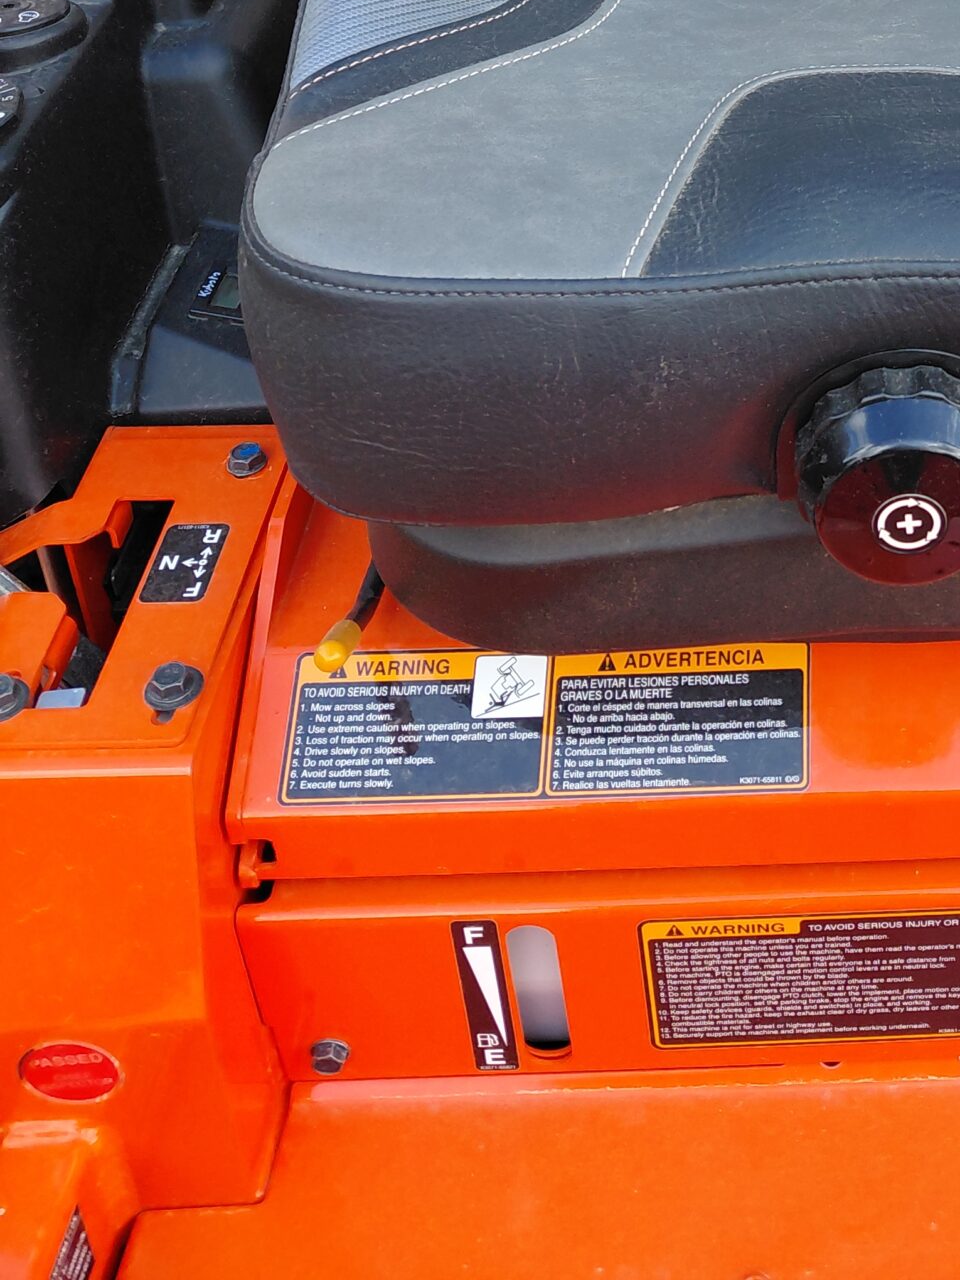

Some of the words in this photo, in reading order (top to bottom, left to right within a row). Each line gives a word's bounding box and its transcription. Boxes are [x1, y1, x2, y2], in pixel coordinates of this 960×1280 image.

[203, 529, 222, 543] R
[159, 555, 180, 570] N
[183, 582, 202, 597] F
[624, 649, 765, 669] ADVERTENCIA
[356, 659, 449, 677] WARNING
[561, 679, 588, 690] PARA
[590, 678, 626, 689] EVITAR
[628, 676, 679, 687] LESIONES
[681, 674, 750, 686] PERSONALES
[304, 688, 316, 698] TO
[318, 687, 345, 698] AVOID
[347, 686, 388, 697] SERIOUS
[390, 685, 423, 696] INJURY
[424, 685, 438, 695] OR
[440, 684, 471, 694] DEATH
[561, 691, 602, 701] GRAVES
[604, 690, 613, 700] O
[615, 690, 629, 699] LA
[630, 688, 673, 699] MUERTE
[301, 704, 308, 712] 1.
[311, 703, 332, 712] Mow
[334, 703, 364, 712] across
[366, 702, 395, 711] slopes
[568, 703, 591, 712] Corte
[593, 703, 601, 711] el
[602, 702, 633, 712] césped
[634, 702, 645, 711] de
[647, 702, 678, 710] manera
[681, 699, 725, 709] transversal
[740, 698, 752, 706] las
[754, 697, 783, 706] colinas
[315, 714, 331, 723] Not
[333, 715, 344, 723] up
[347, 713, 364, 722] and
[365, 713, 392, 721] down.
[572, 714, 585, 723] No
[587, 714, 598, 722] de
[626, 713, 648, 721] hacia
[650, 712, 675, 722] abajo.
[296, 726, 304, 735] 2.
[308, 725, 325, 734] Use
[328, 725, 364, 733] extreme
[366, 724, 399, 732] caution
[401, 722, 426, 732] when
[428, 721, 469, 733] operating
[486, 721, 517, 730] slopes.
[295, 737, 303, 745] 3.
[306, 736, 327, 745] Loss
[329, 736, 339, 744] of
[341, 735, 374, 744] traction
[376, 736, 396, 745] may
[398, 734, 423, 743] occur
[424, 733, 449, 742] when
[451, 732, 493, 743] operating
[496, 732, 507, 740] on
[509, 731, 541, 741] slopes.
[294, 748, 302, 756] 4.
[305, 747, 328, 756] Drive
[330, 746, 358, 756] slowly
[374, 746, 406, 755] slopes.
[292, 759, 300, 767] 5.
[303, 759, 316, 767] Do
[319, 759, 333, 767] not
[335, 758, 369, 768] operate
[386, 757, 402, 765] wet
[404, 756, 436, 766] slopes.
[290, 771, 299, 779] 6.
[301, 770, 326, 778] Avoid
[328, 769, 362, 777] sudden
[364, 768, 391, 777] starts.
[290, 781, 298, 790] 7.
[300, 781, 336, 790] Execute
[364, 779, 394, 789] slowly.
[691, 923, 785, 935] WARNING
[824, 923, 855, 932] AVOID
[858, 921, 903, 930] SERIOUS
[905, 920, 942, 928] INJURY
[943, 919, 959, 927] OR
[463, 927, 484, 945] F
[484, 1049, 506, 1065] E
